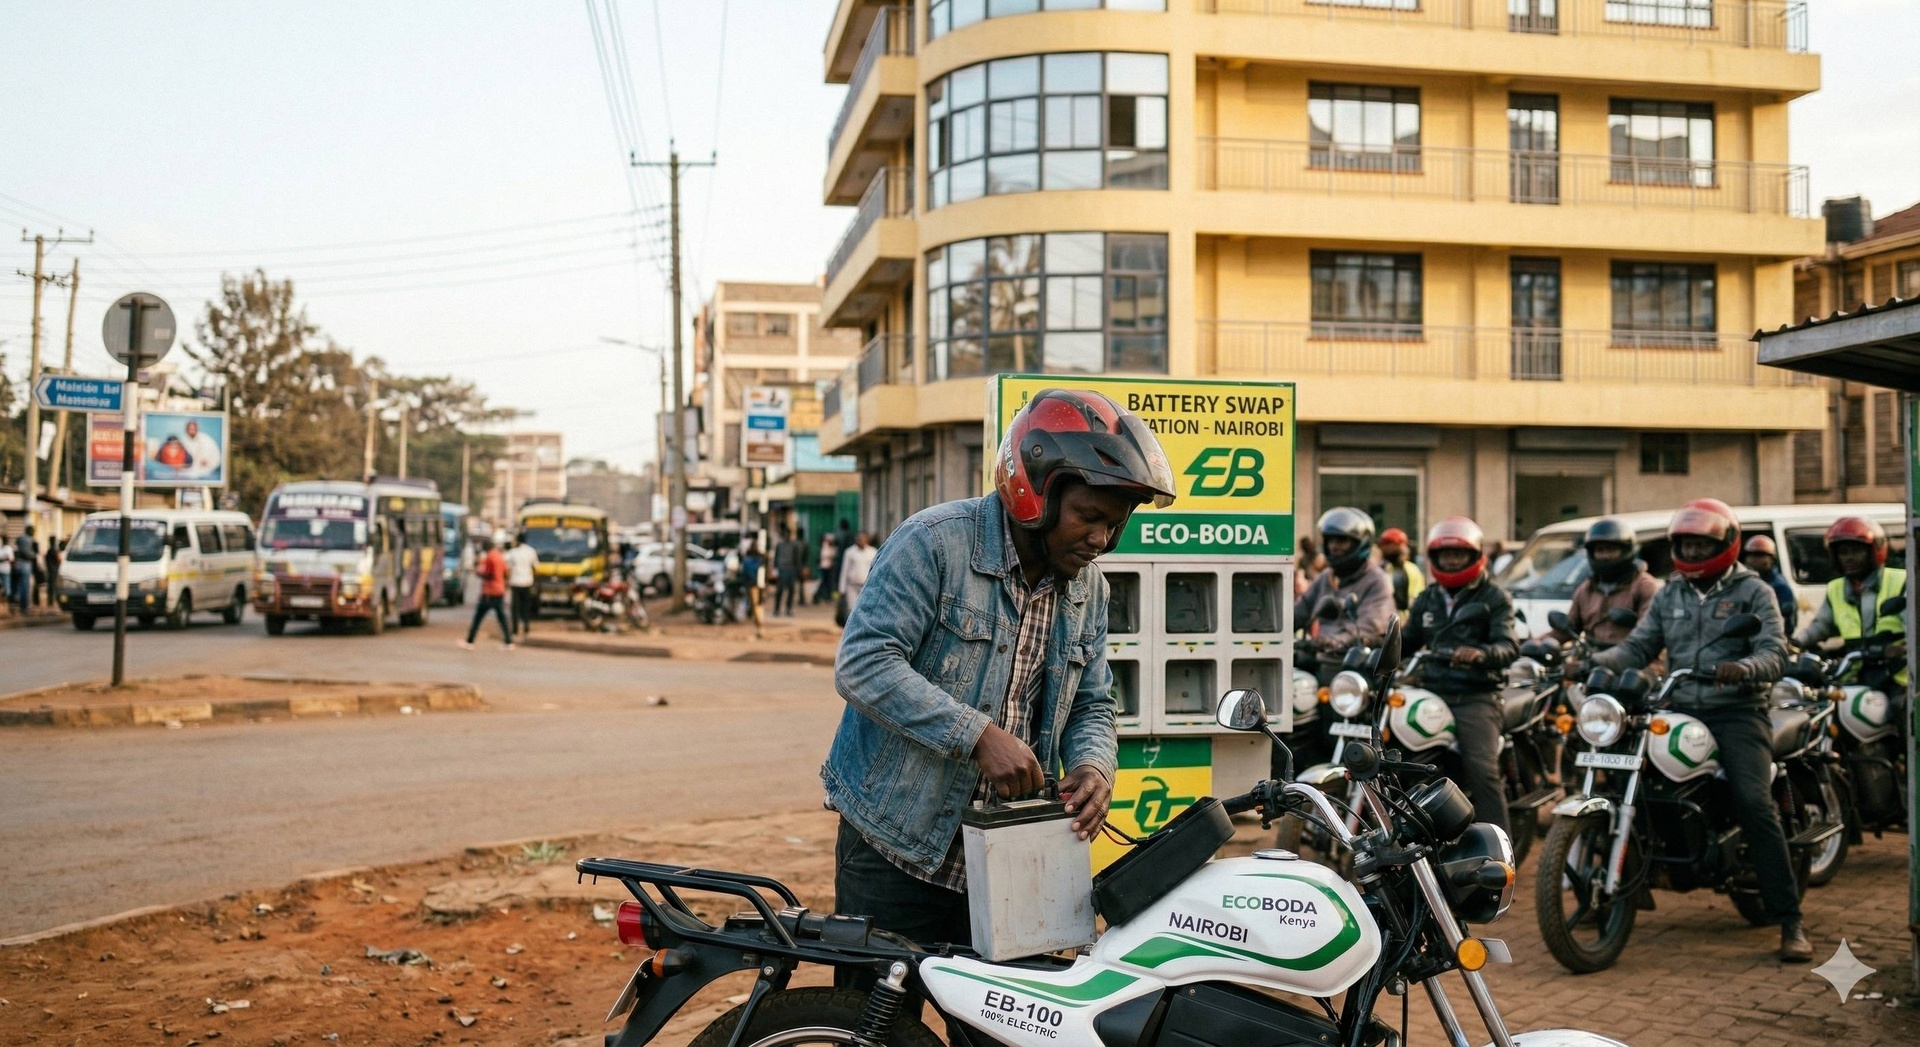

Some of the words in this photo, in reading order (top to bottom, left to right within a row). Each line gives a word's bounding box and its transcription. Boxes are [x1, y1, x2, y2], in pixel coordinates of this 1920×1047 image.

[1128, 393, 1219, 413] BATTERY
[1226, 396, 1284, 414] SWAP
[1142, 419, 1199, 435] ATION
[1214, 420, 1283, 436] NAIROBI
[1183, 447, 1265, 497] EB
[1140, 523, 1269, 545] ECO-BODA
[1222, 894, 1318, 915] ECOBODA
[1169, 912, 1248, 943] NAIROBI
[1279, 915, 1316, 929] Kenya
[984, 990, 1063, 1027] EB-100
[980, 1009, 1004, 1024] 100%
[1007, 1017, 1057, 1039] ELECTRIC
